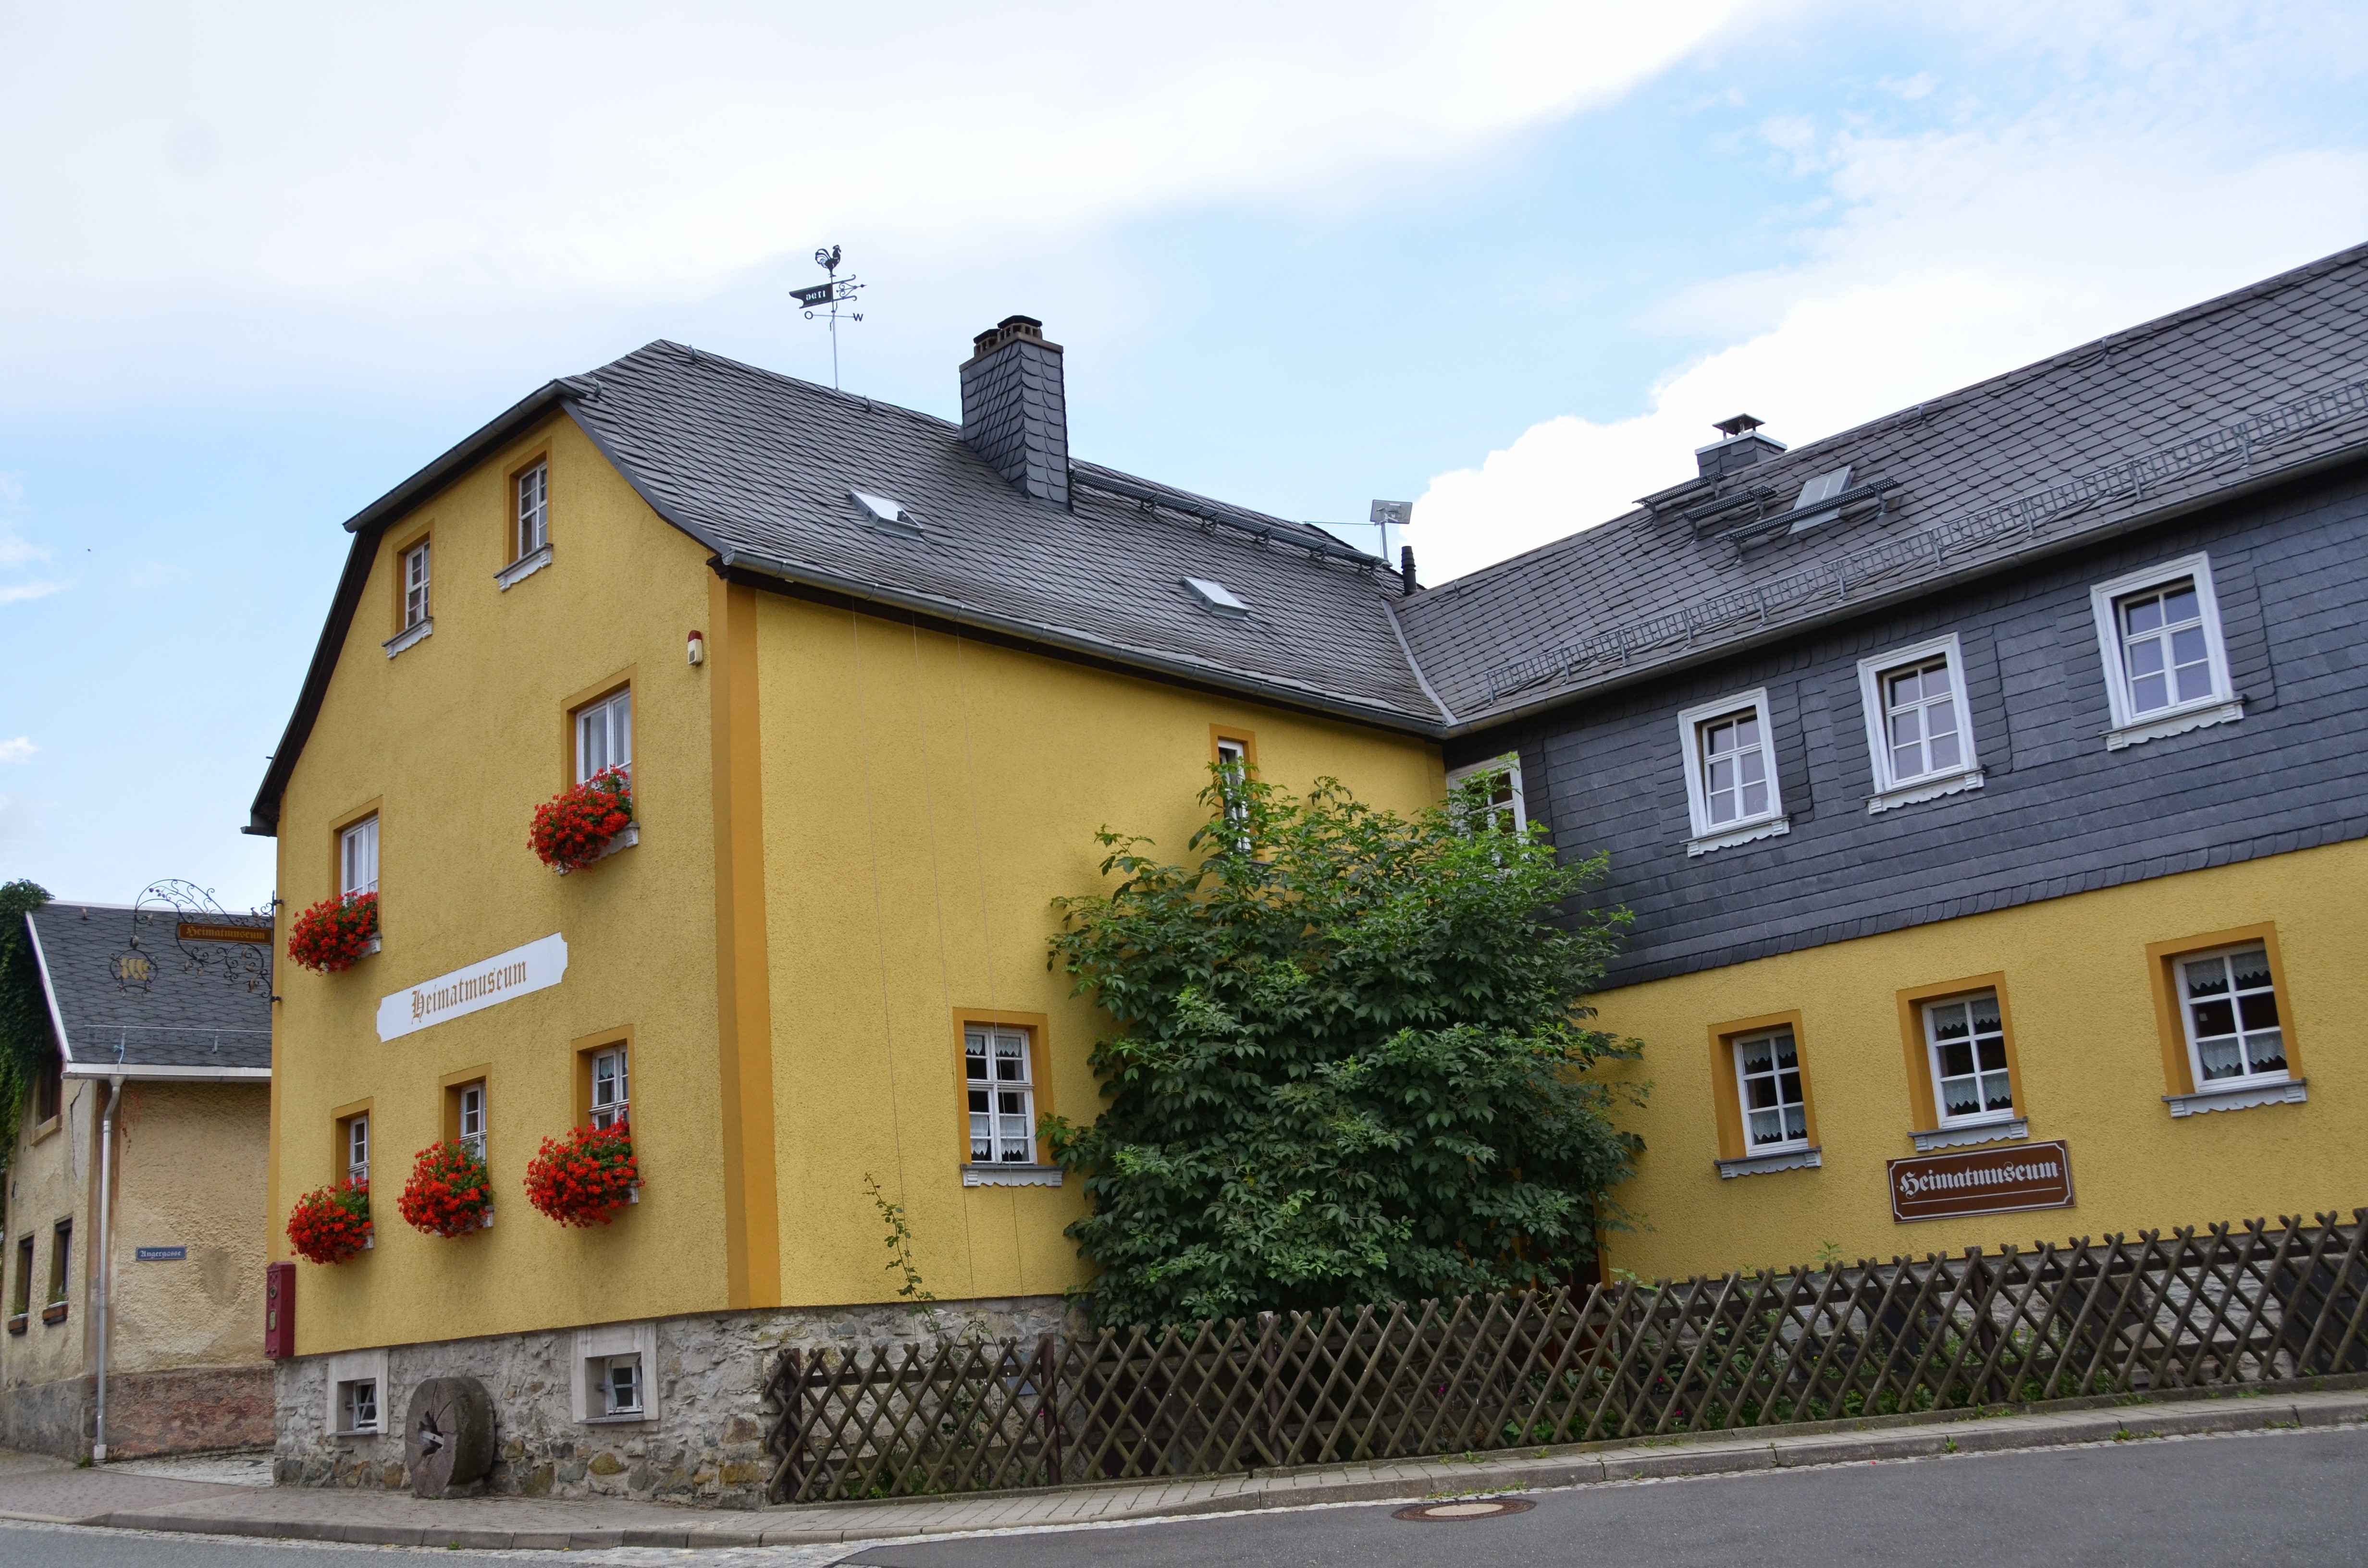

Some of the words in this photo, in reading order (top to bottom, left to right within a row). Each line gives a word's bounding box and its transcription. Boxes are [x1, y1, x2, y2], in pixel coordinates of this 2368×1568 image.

[852, 313, 863, 321] W
[186, 925, 265, 940] Heimatmuseum
[411, 961, 527, 1025] Heimatmuseum
[1899, 1162, 2059, 1199] Heimatmuseum
